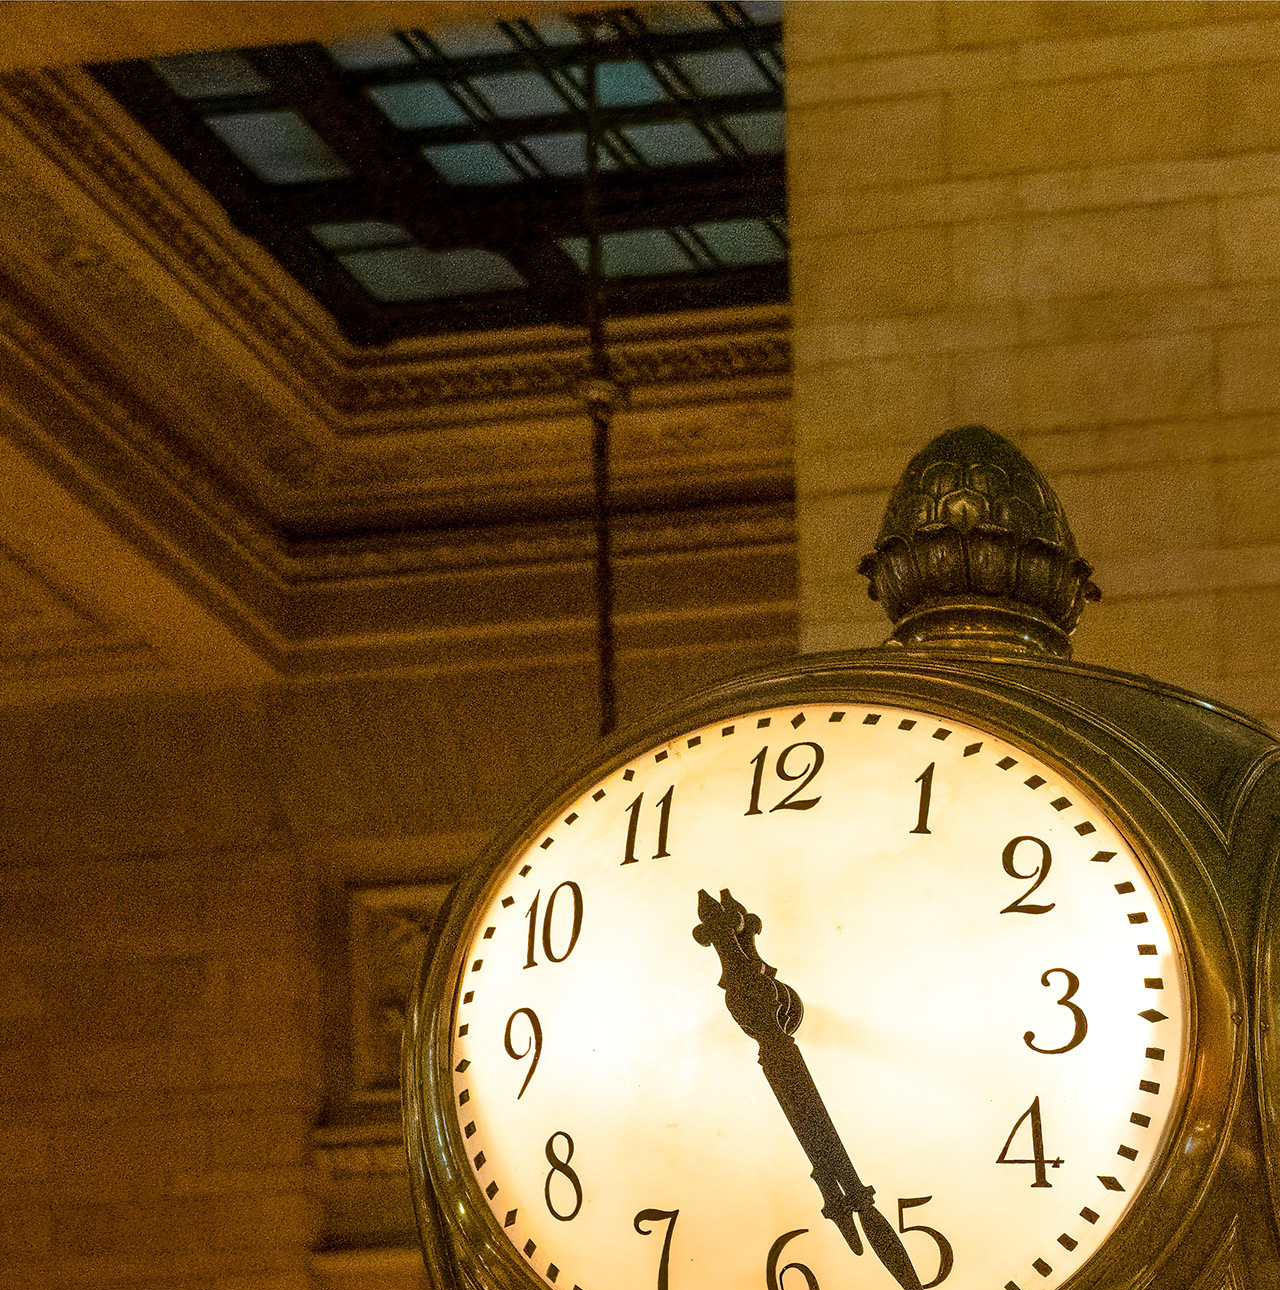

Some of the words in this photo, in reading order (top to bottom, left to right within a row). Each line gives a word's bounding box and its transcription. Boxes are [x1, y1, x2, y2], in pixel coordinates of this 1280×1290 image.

[744, 742, 824, 816] 12
[910, 762, 935, 834] 1
[620, 784, 675, 865] 11
[1000, 836, 1055, 914] 2
[522, 881, 584, 969] 10
[505, 1008, 542, 1099] 9
[1024, 968, 1087, 1054] 3
[545, 1132, 582, 1221] 8
[996, 1096, 1064, 1187] 4
[898, 1195, 954, 1290] 5
